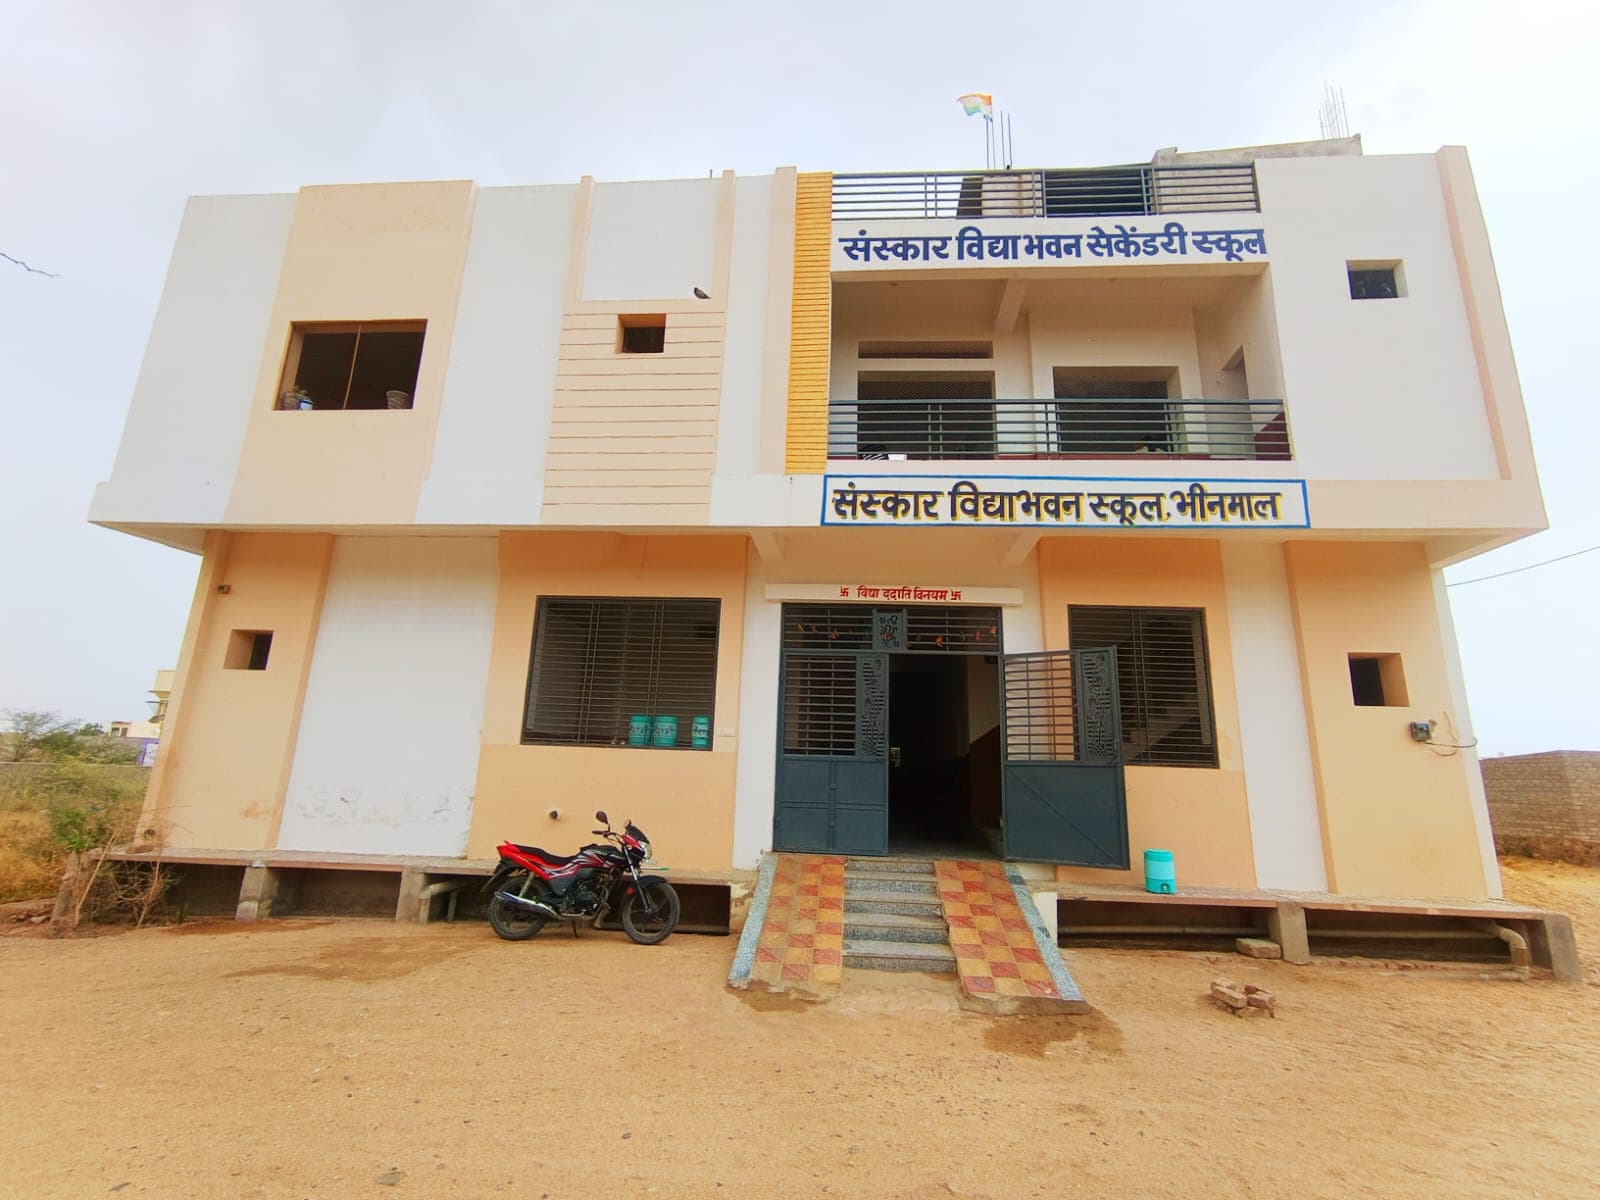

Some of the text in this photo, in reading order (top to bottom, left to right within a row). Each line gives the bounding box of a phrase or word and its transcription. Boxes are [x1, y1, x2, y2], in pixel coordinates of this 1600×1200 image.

[838, 229, 952, 262] संस्कार
[1087, 222, 1188, 257] सेकेंडरी
[1192, 229, 1267, 262] स्कूल
[832, 482, 944, 520] संस्कार
[1170, 483, 1281, 521] भीनमाल
[857, 585, 880, 598] विद्या
[882, 586, 912, 600] ददाति
